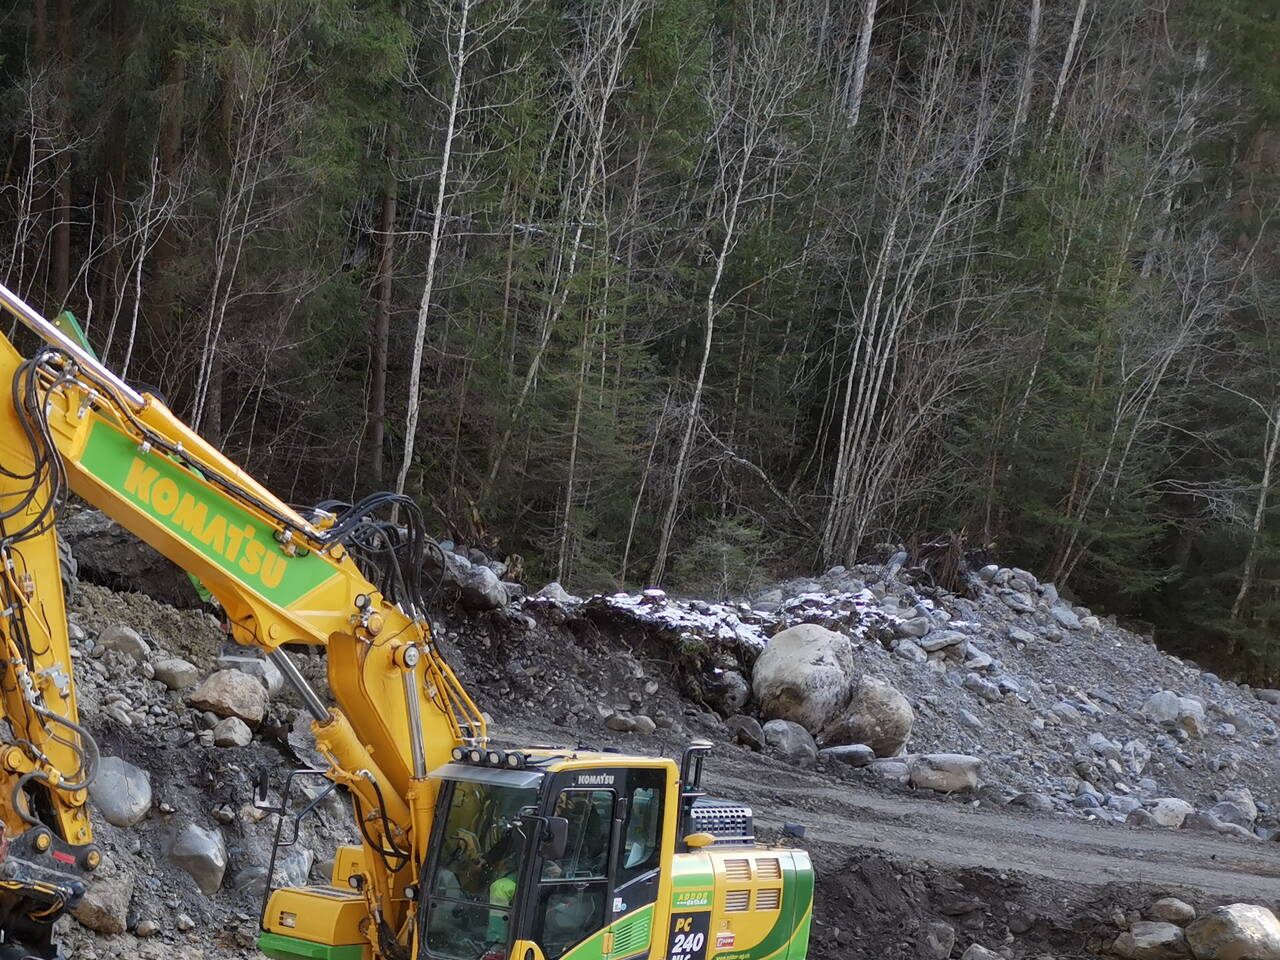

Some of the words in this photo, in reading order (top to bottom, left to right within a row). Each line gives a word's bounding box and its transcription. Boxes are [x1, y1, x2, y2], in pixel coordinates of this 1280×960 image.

[124, 457, 288, 588] KOMATSU
[578, 773, 615, 785] KOMATSU
[675, 917, 693, 932] PC
[672, 933, 704, 953] 240
